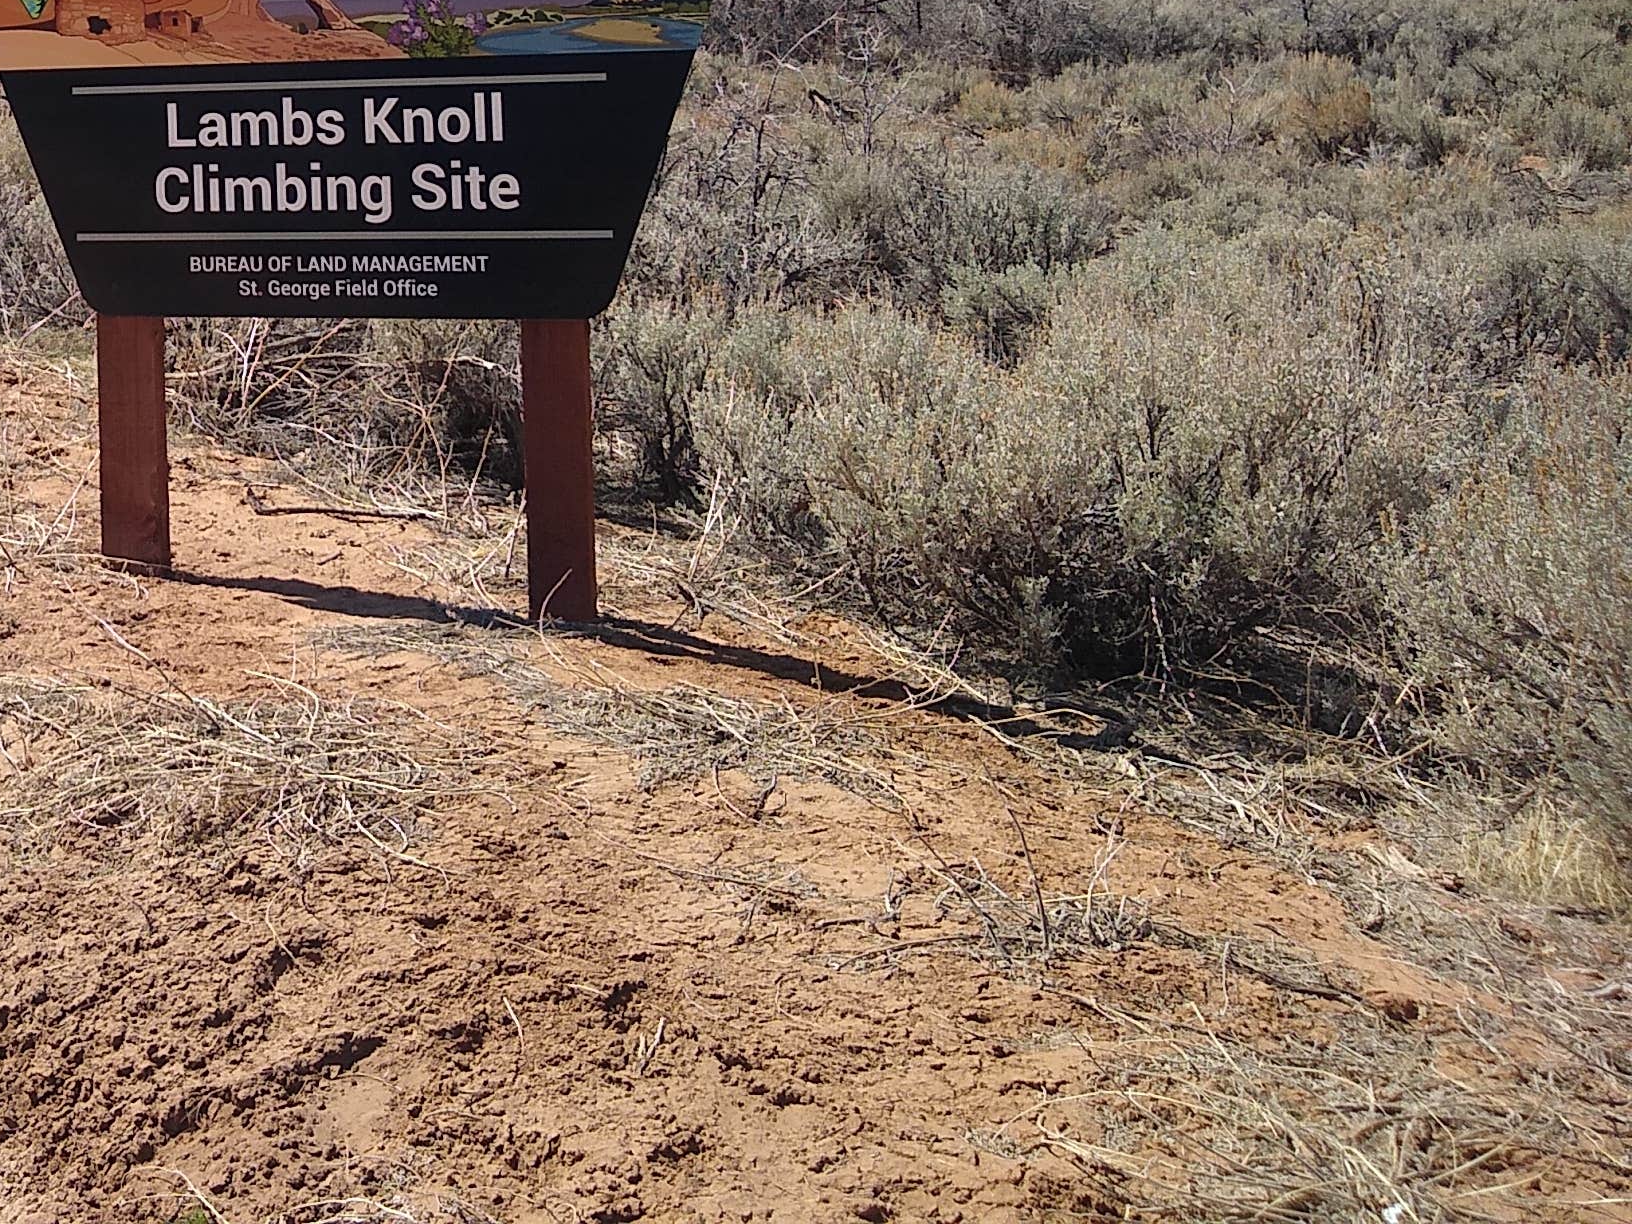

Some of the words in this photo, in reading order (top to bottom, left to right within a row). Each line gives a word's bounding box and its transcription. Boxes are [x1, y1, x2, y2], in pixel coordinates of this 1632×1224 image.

[167, 97, 344, 147] Lambs
[364, 91, 504, 144] Knoll
[155, 162, 392, 223] Climbing
[411, 160, 520, 211] Site
[189, 256, 263, 272] BUREAU
[267, 255, 292, 272] OF
[296, 255, 347, 272] LAND
[352, 255, 489, 272] MANAGEMENT
[238, 279, 264, 296] St.
[268, 279, 331, 300] George
[335, 278, 378, 296] Field
[383, 278, 438, 297] Office
